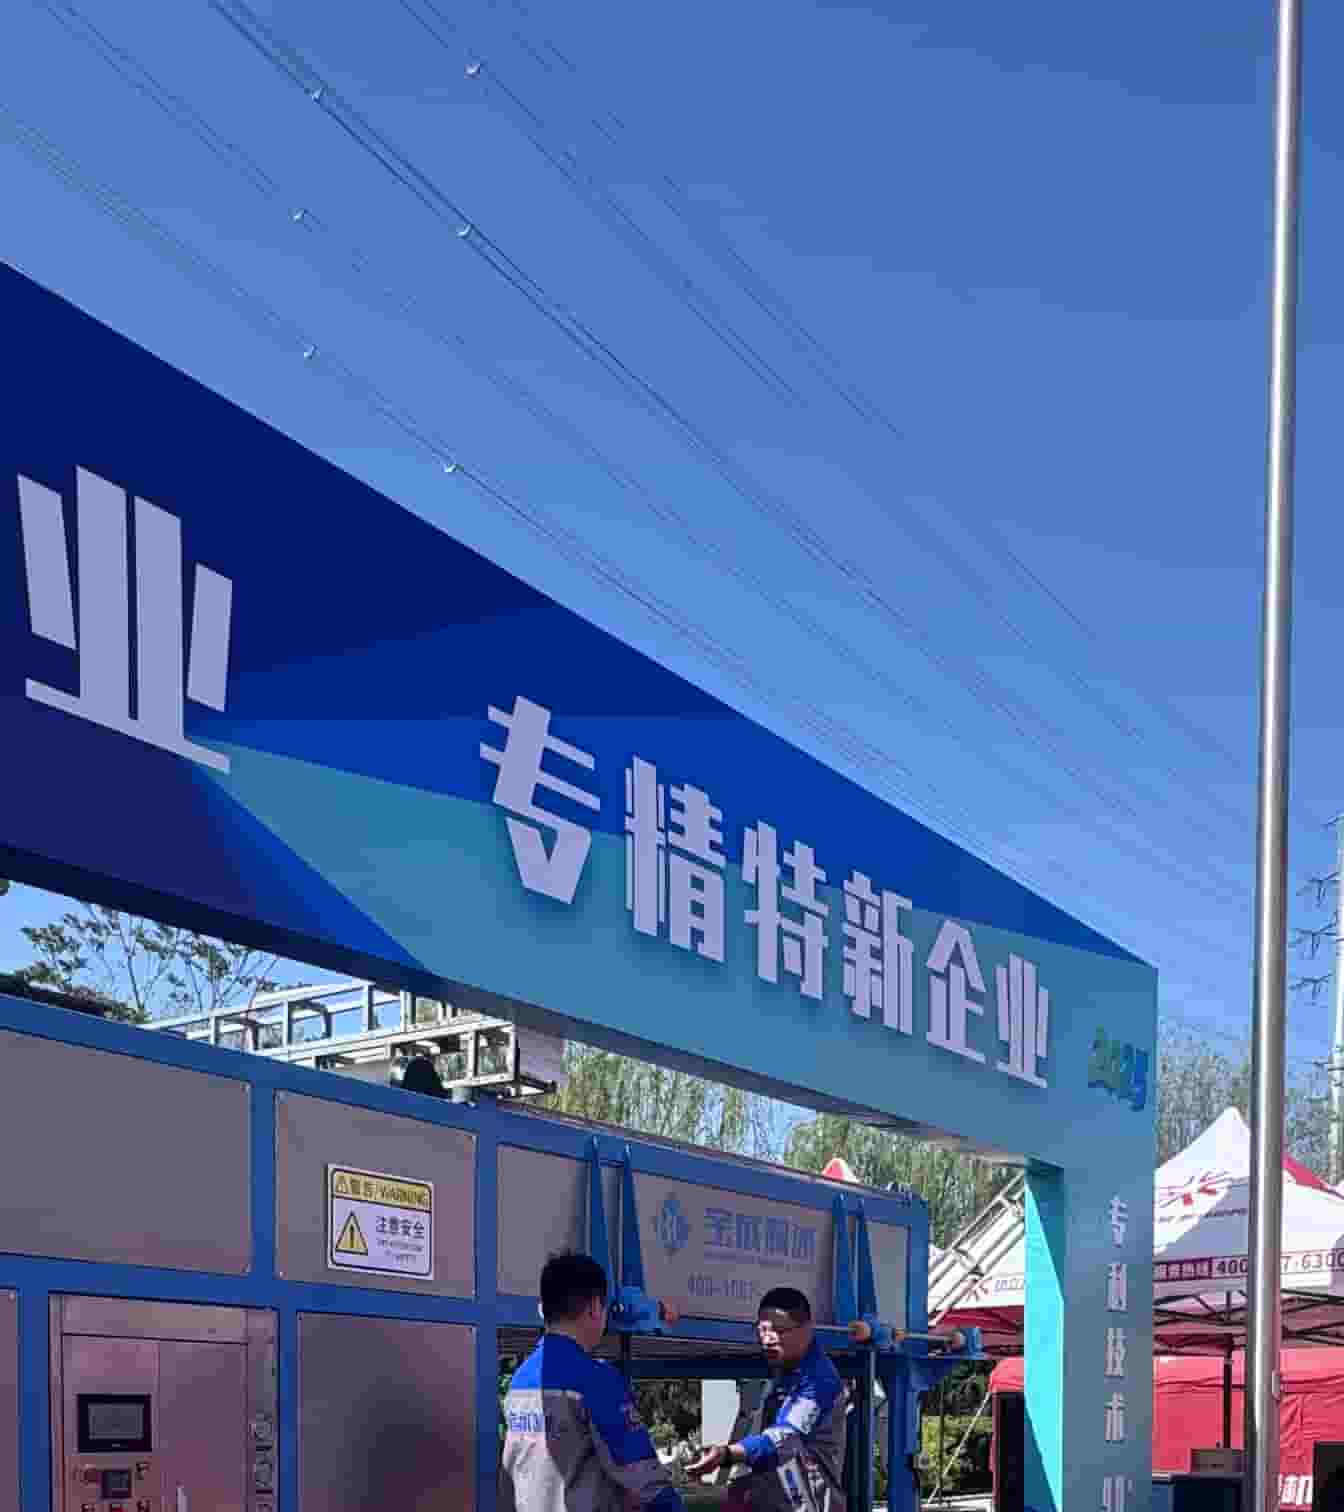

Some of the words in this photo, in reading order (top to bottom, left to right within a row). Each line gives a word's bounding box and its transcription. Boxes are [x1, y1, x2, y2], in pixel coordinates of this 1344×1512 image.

[479, 695, 1050, 1090] 专精特新企业
[375, 1215, 425, 1240] 注意安全
[1105, 1195, 1130, 1442] 专利技术
